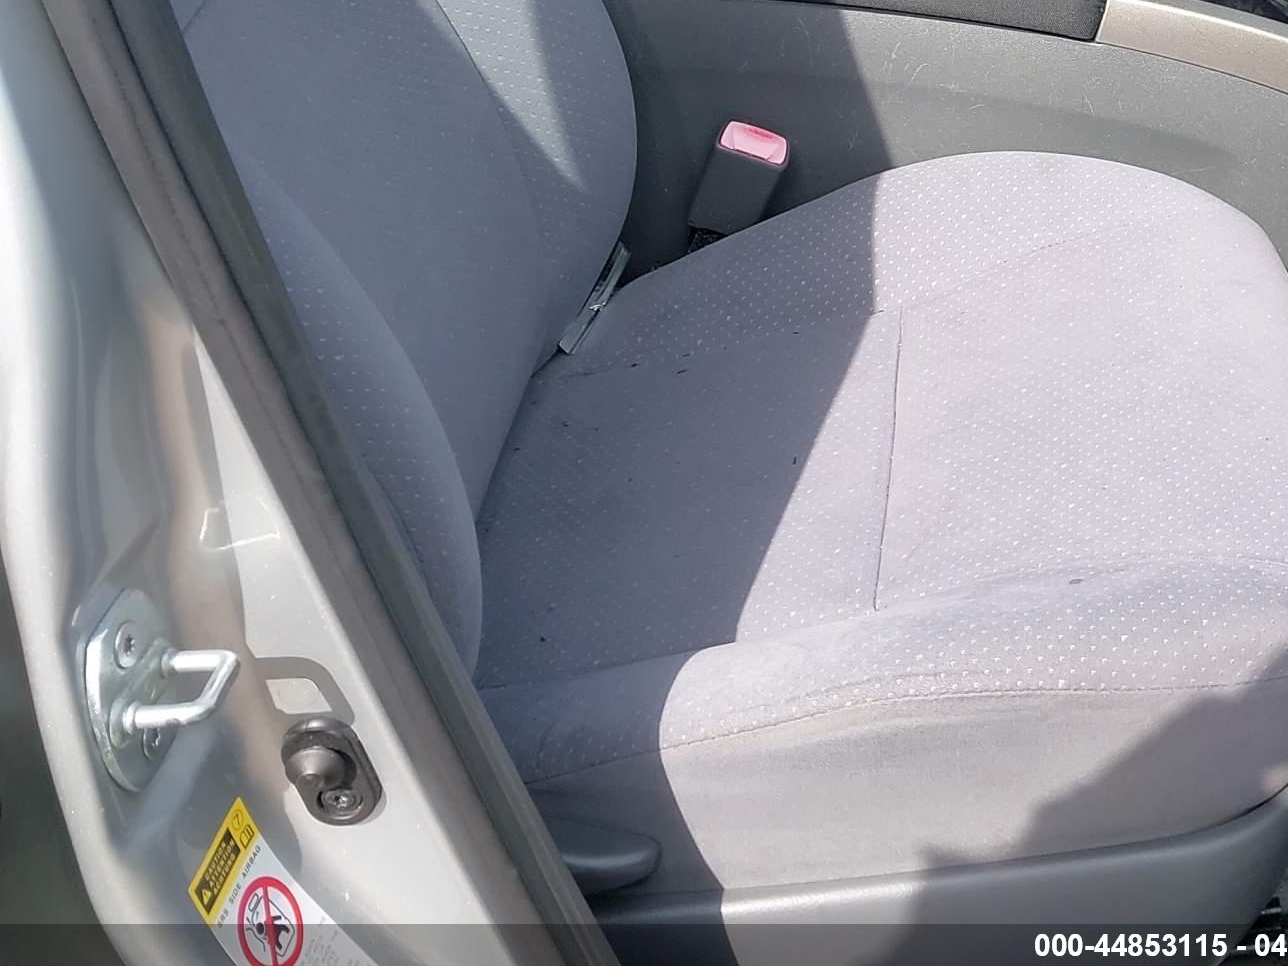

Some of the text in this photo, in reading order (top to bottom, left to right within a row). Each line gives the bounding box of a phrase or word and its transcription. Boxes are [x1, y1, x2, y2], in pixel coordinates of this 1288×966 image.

[204, 842, 227, 882] CAUTION
[208, 839, 236, 890] ATTENTION
[212, 852, 237, 897] ACHTUNG
[229, 883, 242, 905] SIDE
[241, 845, 262, 880] AIRBAG
